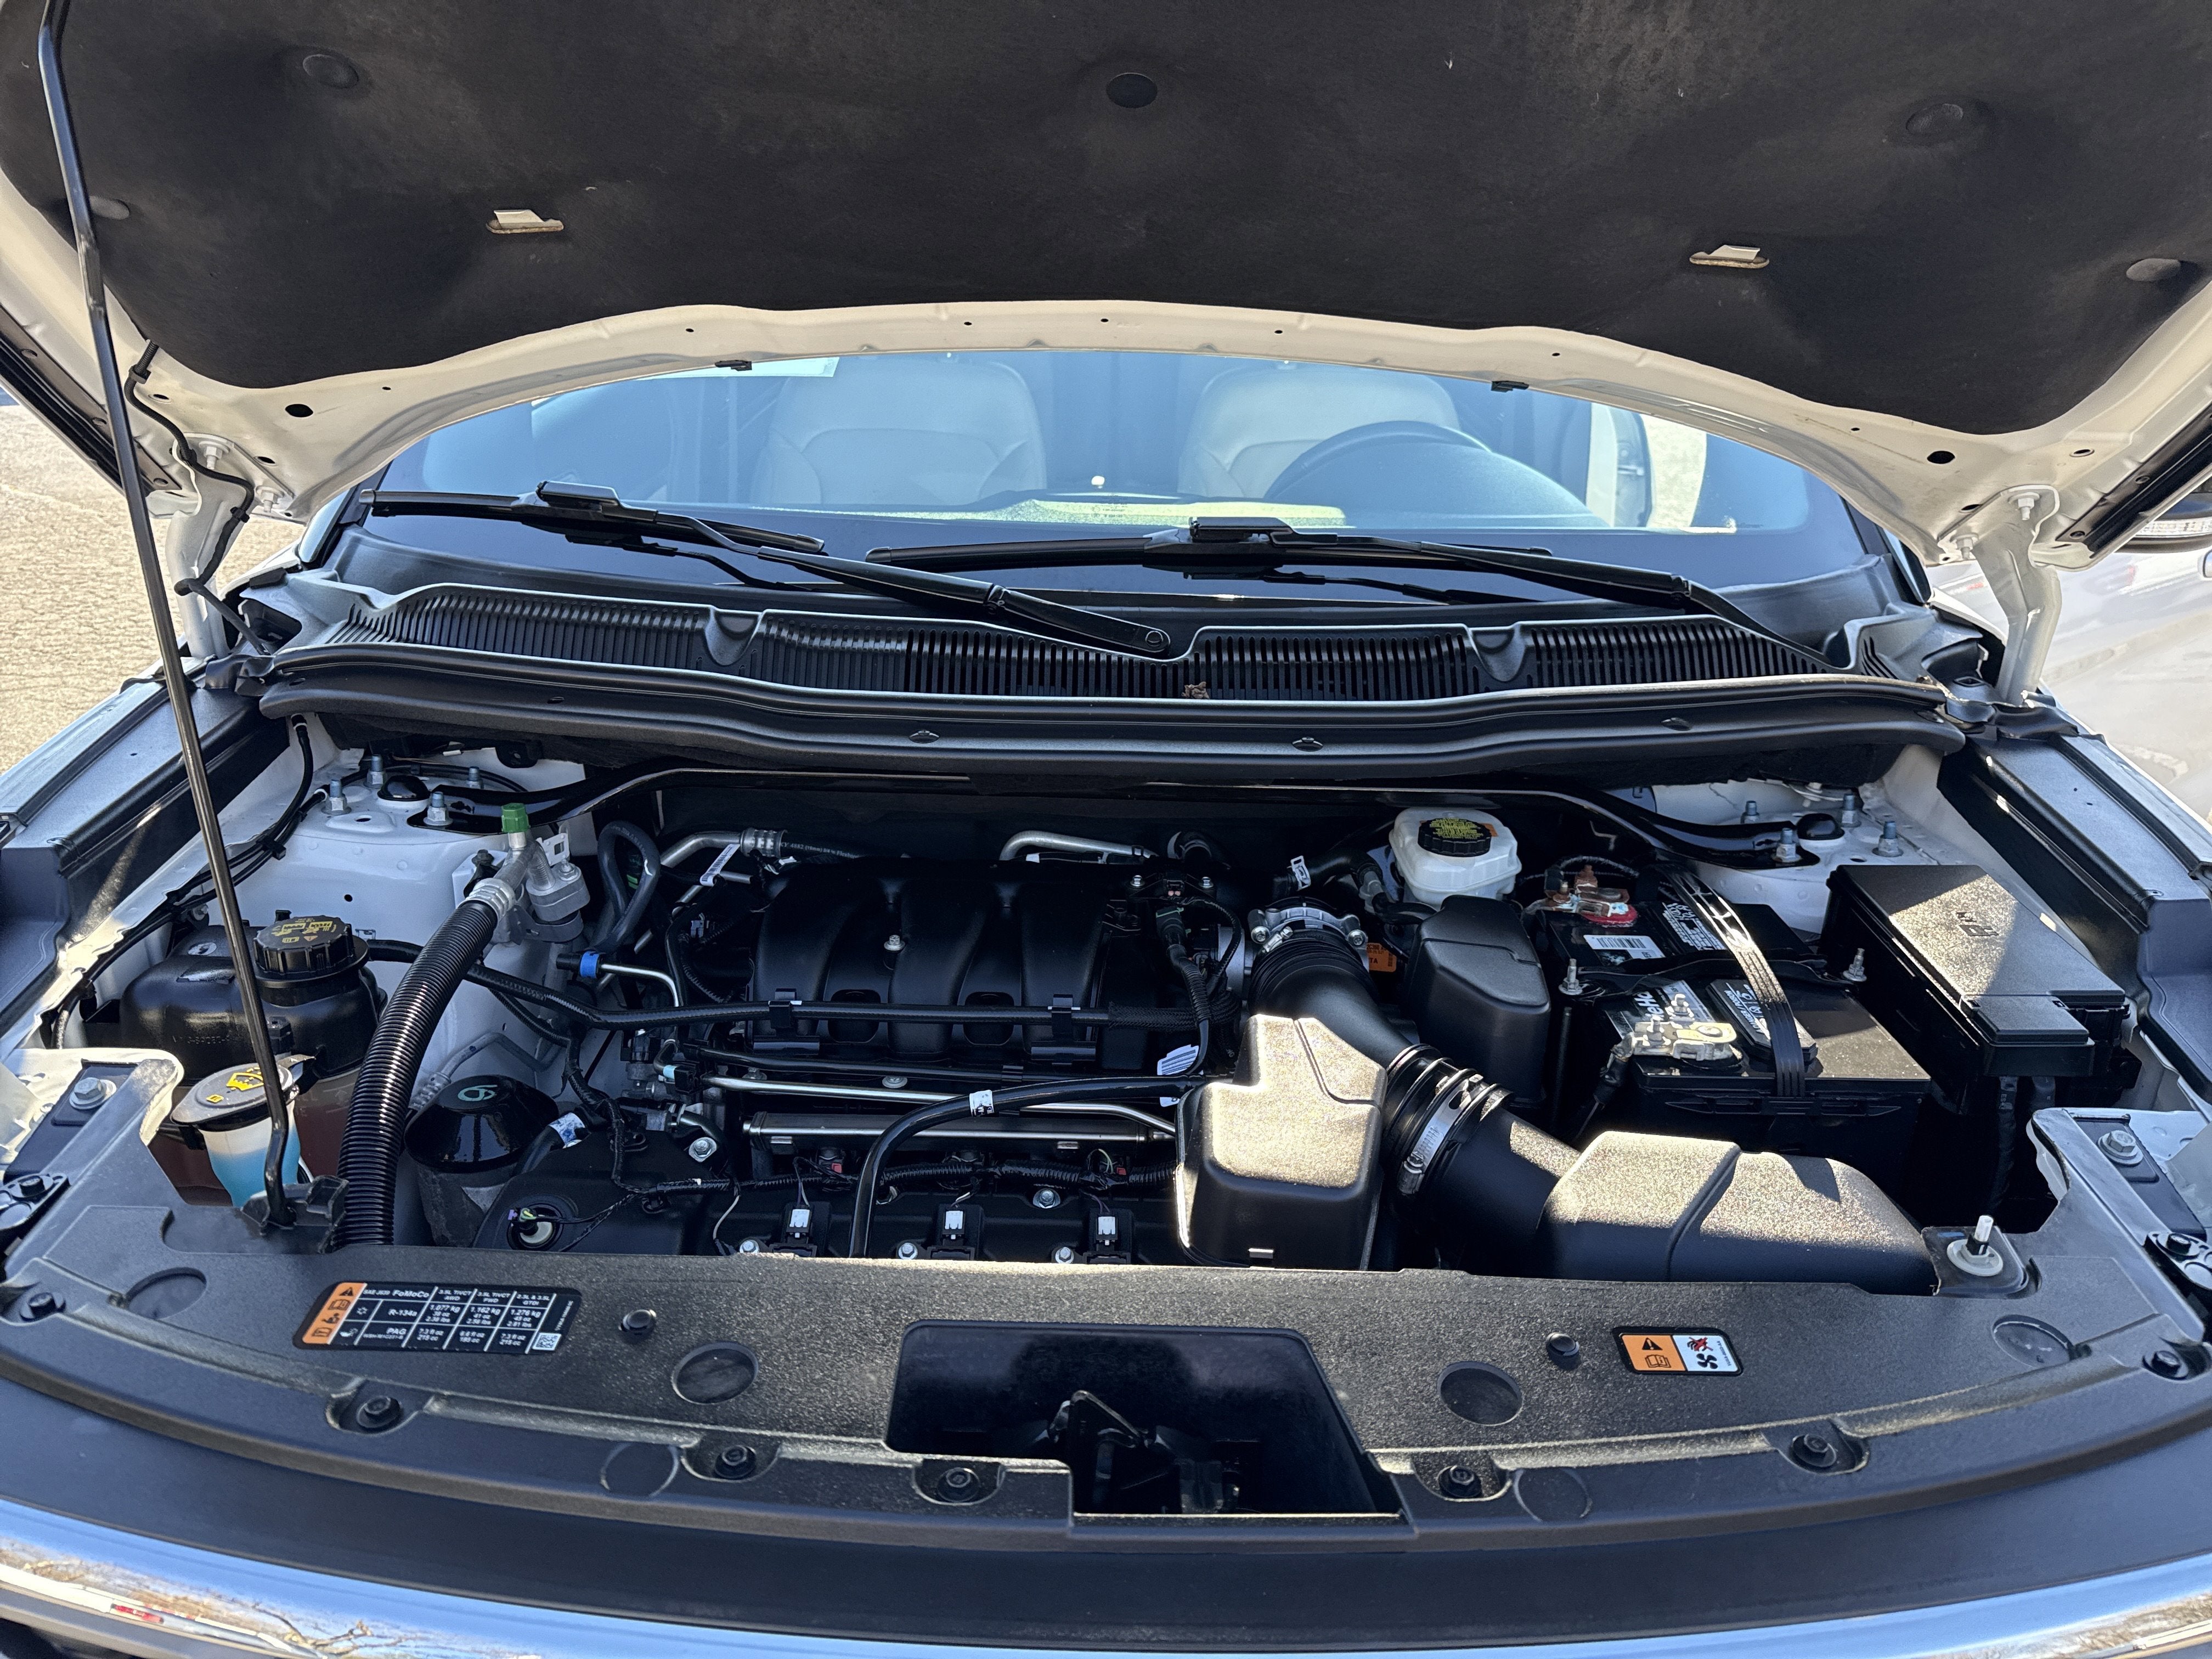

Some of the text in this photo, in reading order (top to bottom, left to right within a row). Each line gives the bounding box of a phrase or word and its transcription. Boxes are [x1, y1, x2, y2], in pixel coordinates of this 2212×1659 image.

[392, 1290, 430, 1298] FoMoCo
[387, 1308, 417, 1317] R-134a
[531, 1310, 541, 1318] kg
